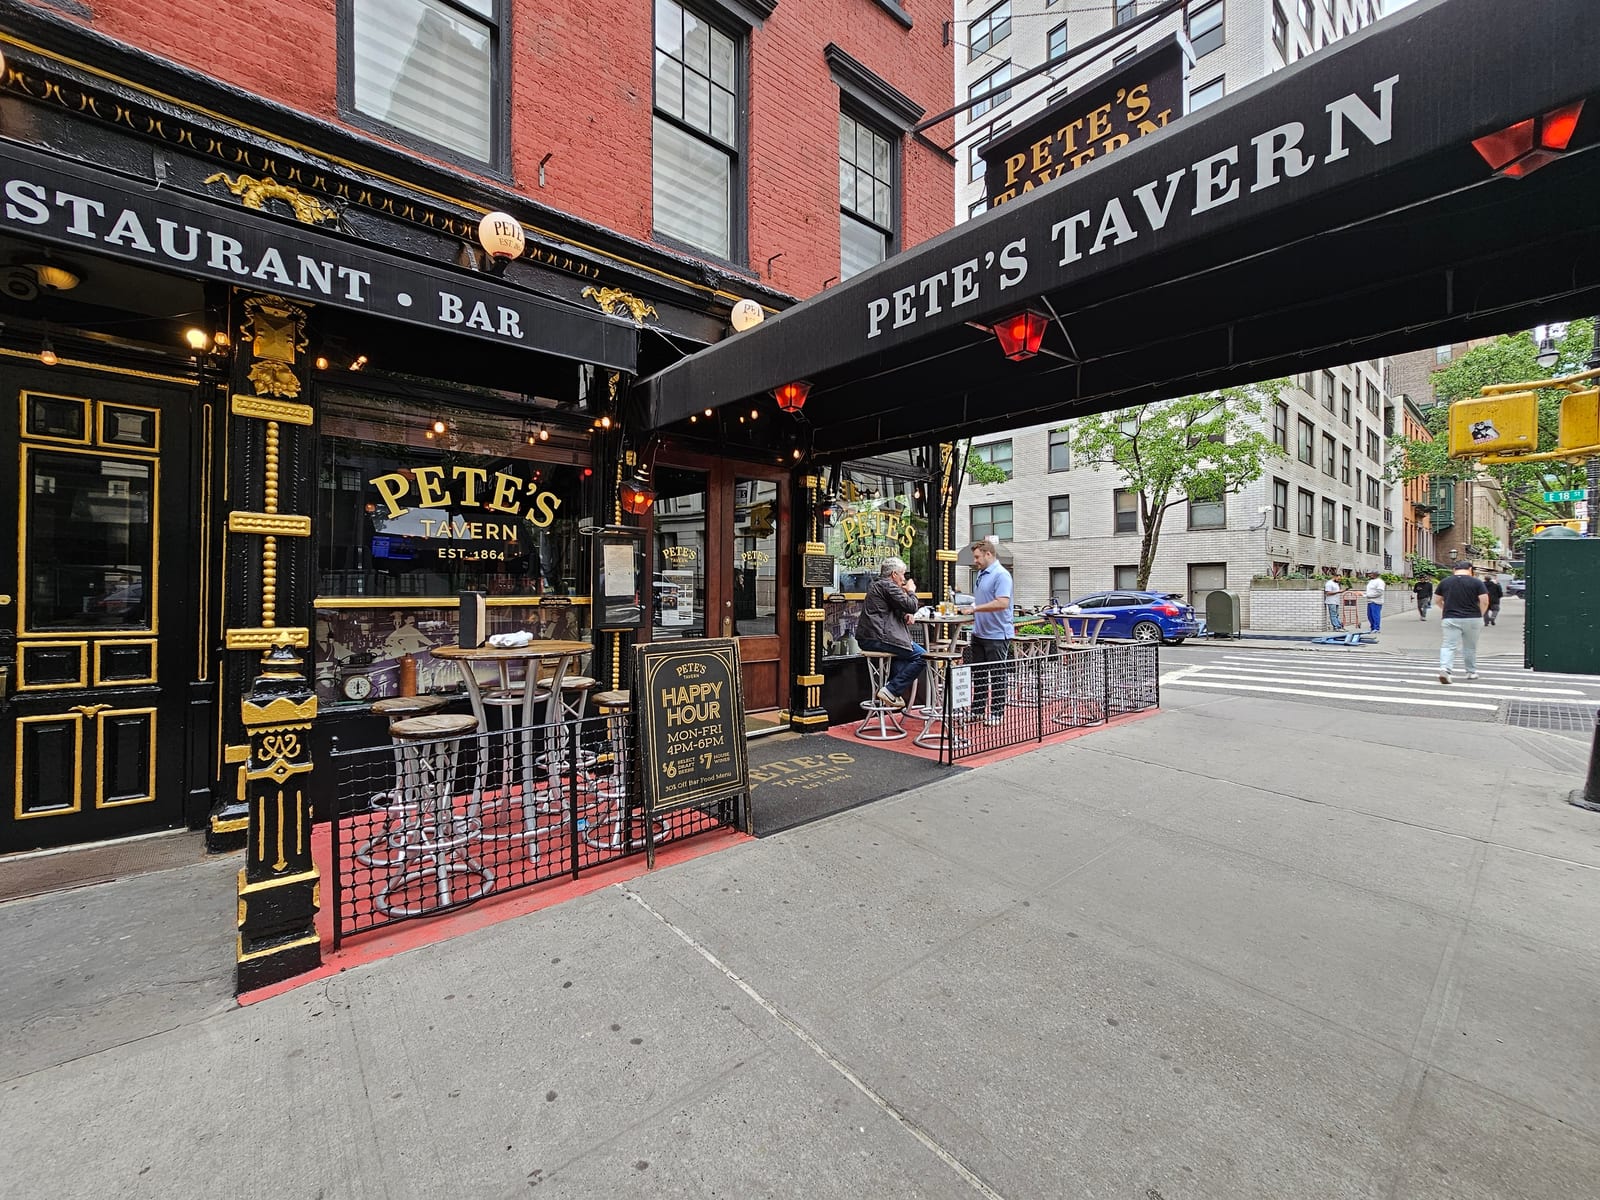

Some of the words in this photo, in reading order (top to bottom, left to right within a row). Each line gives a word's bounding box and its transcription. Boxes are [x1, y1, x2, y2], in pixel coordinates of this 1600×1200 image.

[1004, 83, 1152, 187] PETE'S
[866, 238, 1029, 340] PETE'S
[1051, 74, 1399, 267] TAVERN
[5, 179, 371, 305] STAURANT
[438, 291, 524, 340] BAR
[369, 466, 562, 528] PETE'S
[1558, 492, 1570, 500] 18
[420, 519, 518, 541] TAVERN
[841, 511, 916, 548] PETE'S
[438, 548, 469, 559] EST.
[473, 550, 505, 561] 1864
[662, 546, 697, 560] PETE'S
[741, 550, 770, 563] PETE'S
[676, 662, 707, 676] PETE'S
[661, 681, 723, 708] HAPPY
[667, 701, 721, 728] HOUR
[667, 724, 722, 744] MON-FRI
[667, 735, 724, 756] 4PM-6PM
[662, 760, 677, 778] $6
[699, 752, 713, 769] $7
[750, 752, 856, 792] ETE'S
[771, 766, 846, 788] TAVERN
